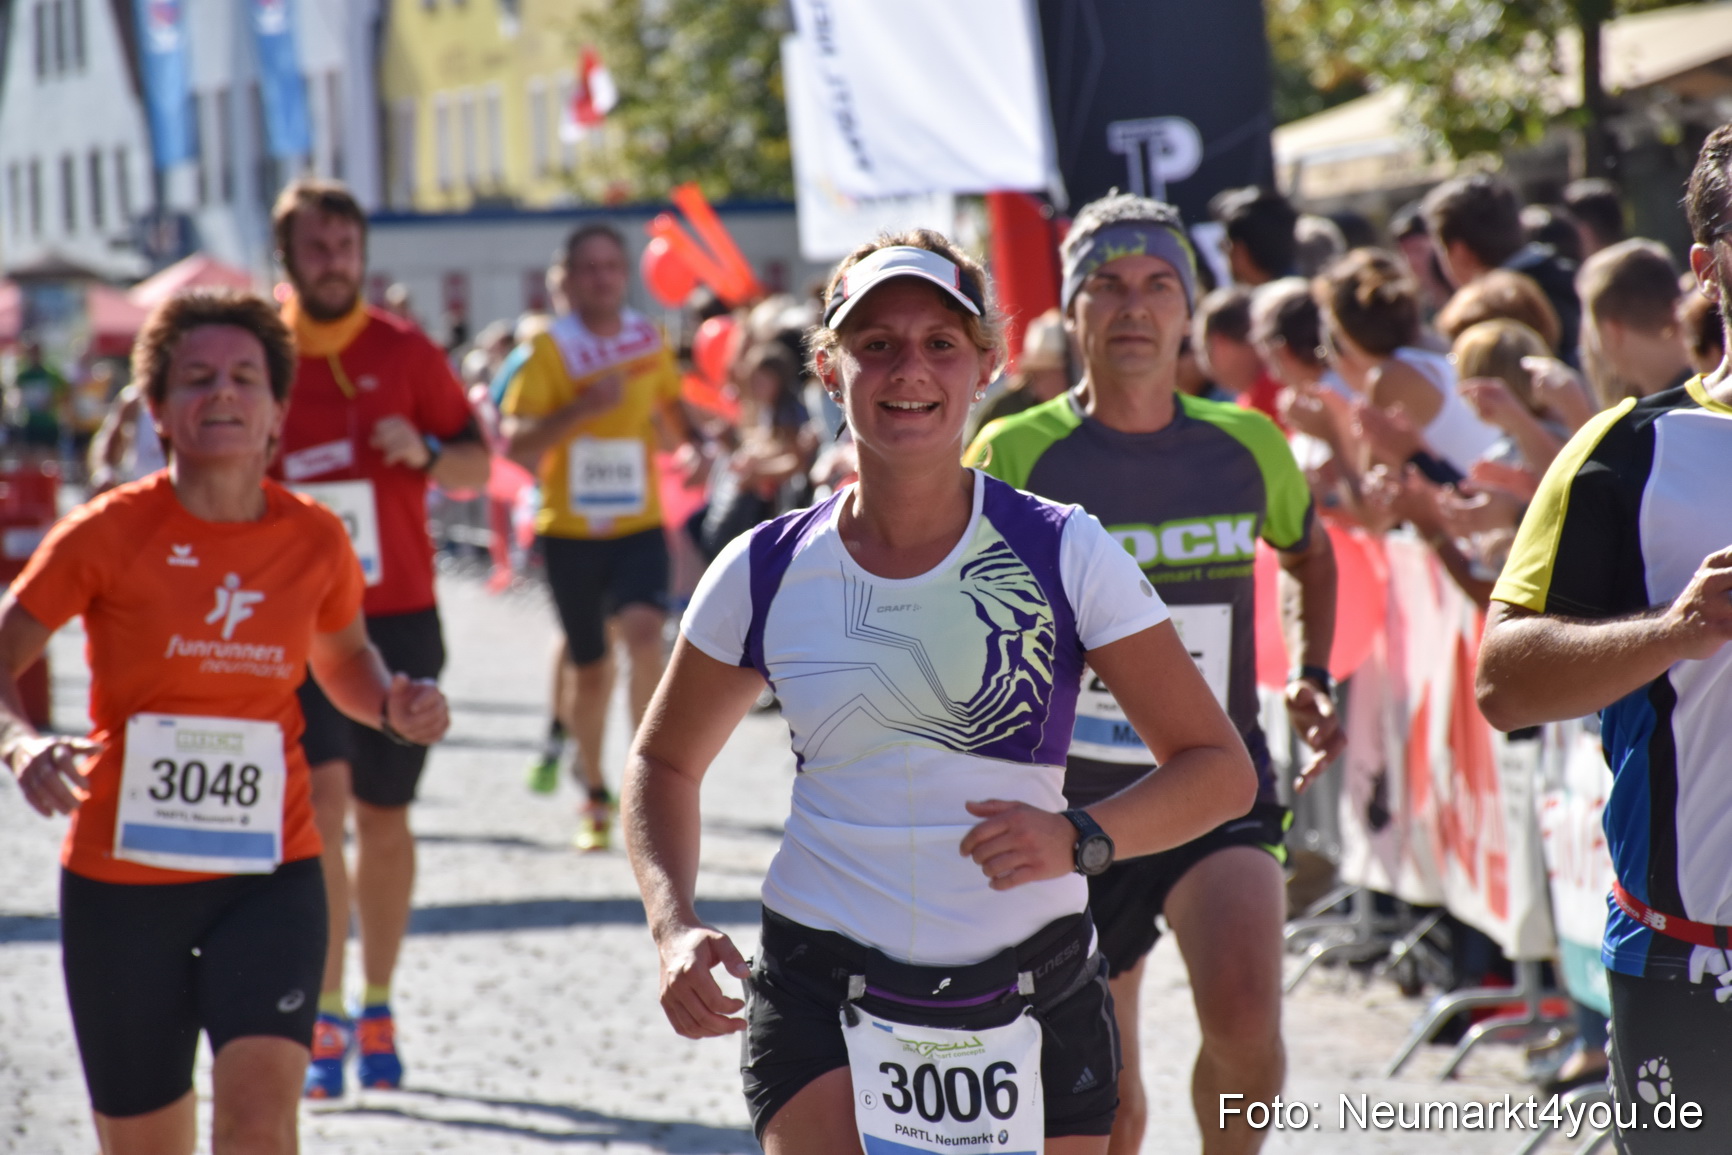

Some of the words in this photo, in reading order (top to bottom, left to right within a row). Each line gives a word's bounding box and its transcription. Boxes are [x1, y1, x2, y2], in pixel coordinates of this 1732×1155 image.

[876, 604, 913, 613] CRAFT
[164, 634, 285, 662] funrunners
[148, 757, 261, 808] 3048
[953, 1047, 986, 1059] concepts
[878, 1060, 1019, 1124] 3006
[894, 1123, 933, 1143] PARTL
[935, 1132, 994, 1147] Neumarkt
